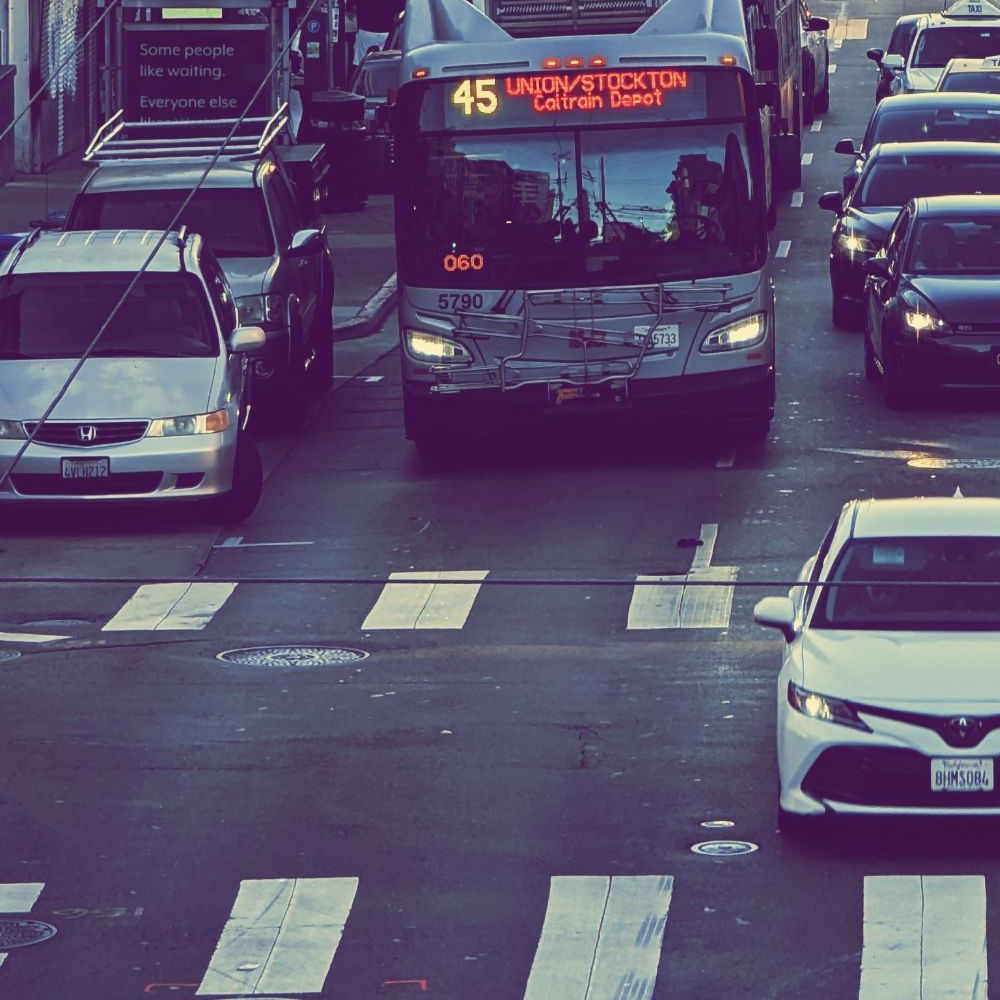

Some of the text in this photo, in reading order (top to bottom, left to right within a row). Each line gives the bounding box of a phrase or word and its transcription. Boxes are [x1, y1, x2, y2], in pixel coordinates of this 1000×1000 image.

[968, 4, 983, 13] TAXI
[140, 43, 235, 60] Some people
[140, 64, 226, 81] like waiting.
[452, 71, 688, 116] 45 UNION/STOCKTON
[609, 89, 663, 108] Depot
[140, 95, 238, 112] Everyone else
[443, 253, 485, 272] 060
[437, 293, 485, 310] 5790
